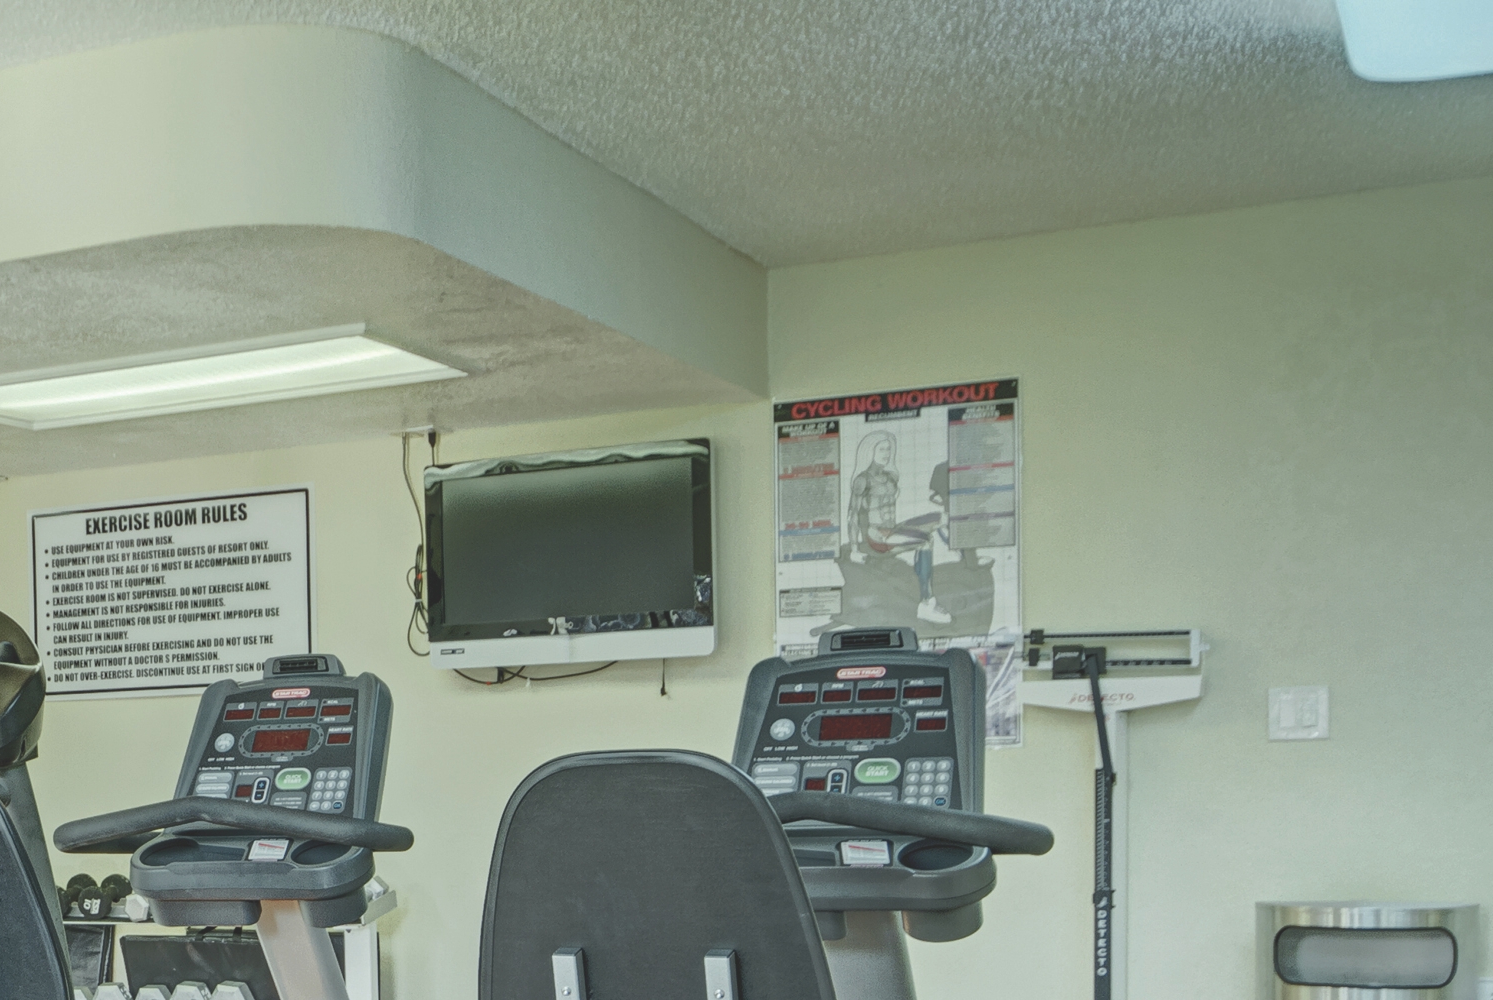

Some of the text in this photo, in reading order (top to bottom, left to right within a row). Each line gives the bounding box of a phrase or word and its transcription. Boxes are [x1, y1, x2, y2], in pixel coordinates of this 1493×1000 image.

[791, 382, 999, 420] CYCLING WORKOUT
[85, 503, 247, 535] EXERCISE ROOM RULES
[51, 537, 174, 555] USE EQUIPMENT AT YOUR OWN RISK.
[52, 541, 270, 568] EQUIPMENT FOR USE BY REGISTERED GUESTS OF RESORT ONLY.
[52, 552, 292, 581] CHILDREN UNDER THE AGE OF 16 MUST BE ACCOMPANIED BY ADULTS
[52, 576, 167, 593] IN ORDER TO USE THE EQUIPMENT.
[53, 582, 271, 606] EXERCISE ROOM IS NOT SUPERVISED. DO NOT EXERCISE ALONE.
[53, 598, 226, 619] MANAGEMENT IS NOT RESPONSIBLE FOR INJURIES.
[53, 608, 279, 632] FOLLOW ALL DIRECTIONS FOR USE OF EQUIPMENT. IMPROPER USE
[53, 631, 129, 645] CAN RESULT IN INJURY.
[54, 635, 273, 657] CONSULT PHYSICIAN BEFORE EXERCISING AND DO NOT USE THE
[54, 659, 92, 670] EQUIPMENT
[94, 657, 126, 668] WITHOUT
[128, 657, 133, 666] A
[172, 652, 220, 663] PERMISSION.
[54, 674, 64, 682] DO
[65, 673, 78, 682] NOT
[136, 667, 184, 678] DISCONTINUE
[186, 666, 200, 675] USE
[202, 665, 210, 675] AT
[212, 664, 233, 674] FIRST
[236, 662, 254, 673] SIGN
[1077, 693, 1134, 702] DEECTO
[1097, 909, 1107, 976] DETECTO
